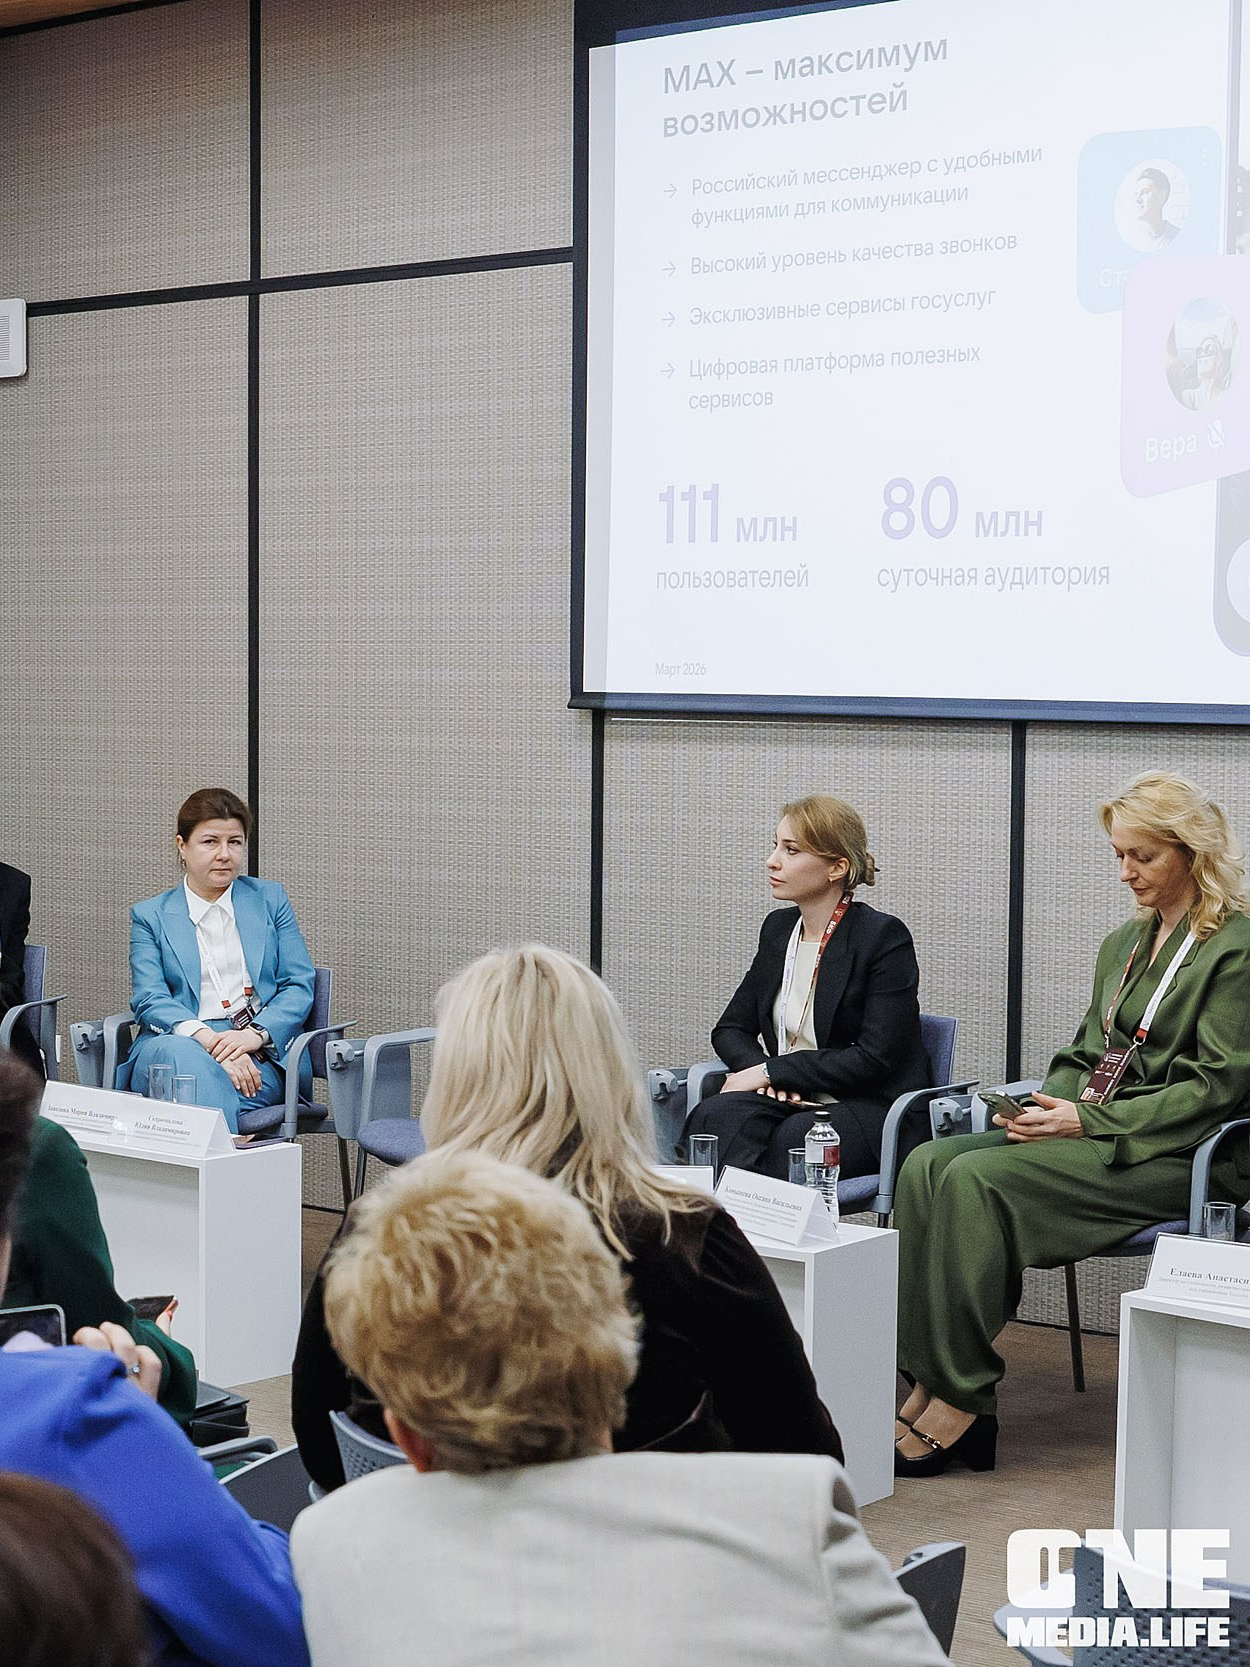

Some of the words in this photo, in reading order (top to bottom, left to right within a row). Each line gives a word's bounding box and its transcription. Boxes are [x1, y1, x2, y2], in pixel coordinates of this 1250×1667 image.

[664, 58, 736, 94] MAX
[775, 39, 948, 81] максимум
[663, 82, 907, 138] возможностей
[693, 169, 797, 196] Российский
[804, 161, 921, 184] мессенджер
[927, 159, 938, 172] с
[943, 148, 1042, 176] удобными
[691, 204, 789, 229] функциями
[794, 201, 825, 220] для
[832, 187, 968, 213] коммуникации
[691, 251, 766, 274] Высокий
[771, 249, 846, 272] уровень
[853, 242, 934, 262] качества
[940, 235, 1017, 254] звонков
[690, 304, 821, 325] Эксклюзивные
[826, 297, 905, 319] сервисы
[911, 291, 996, 312] госуслуг
[690, 357, 778, 381] Цифровая
[784, 352, 884, 375] платформа
[891, 347, 980, 367] полезных
[689, 392, 773, 413] сервисов
[1144, 434, 1198, 464] Вера
[659, 483, 719, 544] 111
[737, 516, 797, 543] млн
[881, 476, 958, 540] 80
[975, 510, 1043, 538] млн
[657, 563, 808, 589] пользователей
[878, 568, 977, 593] суточная
[985, 566, 1110, 592] аудитория
[655, 662, 681, 678] Март
[683, 662, 706, 675] 2026
[1205, 1272, 1250, 1286] Анастаси
